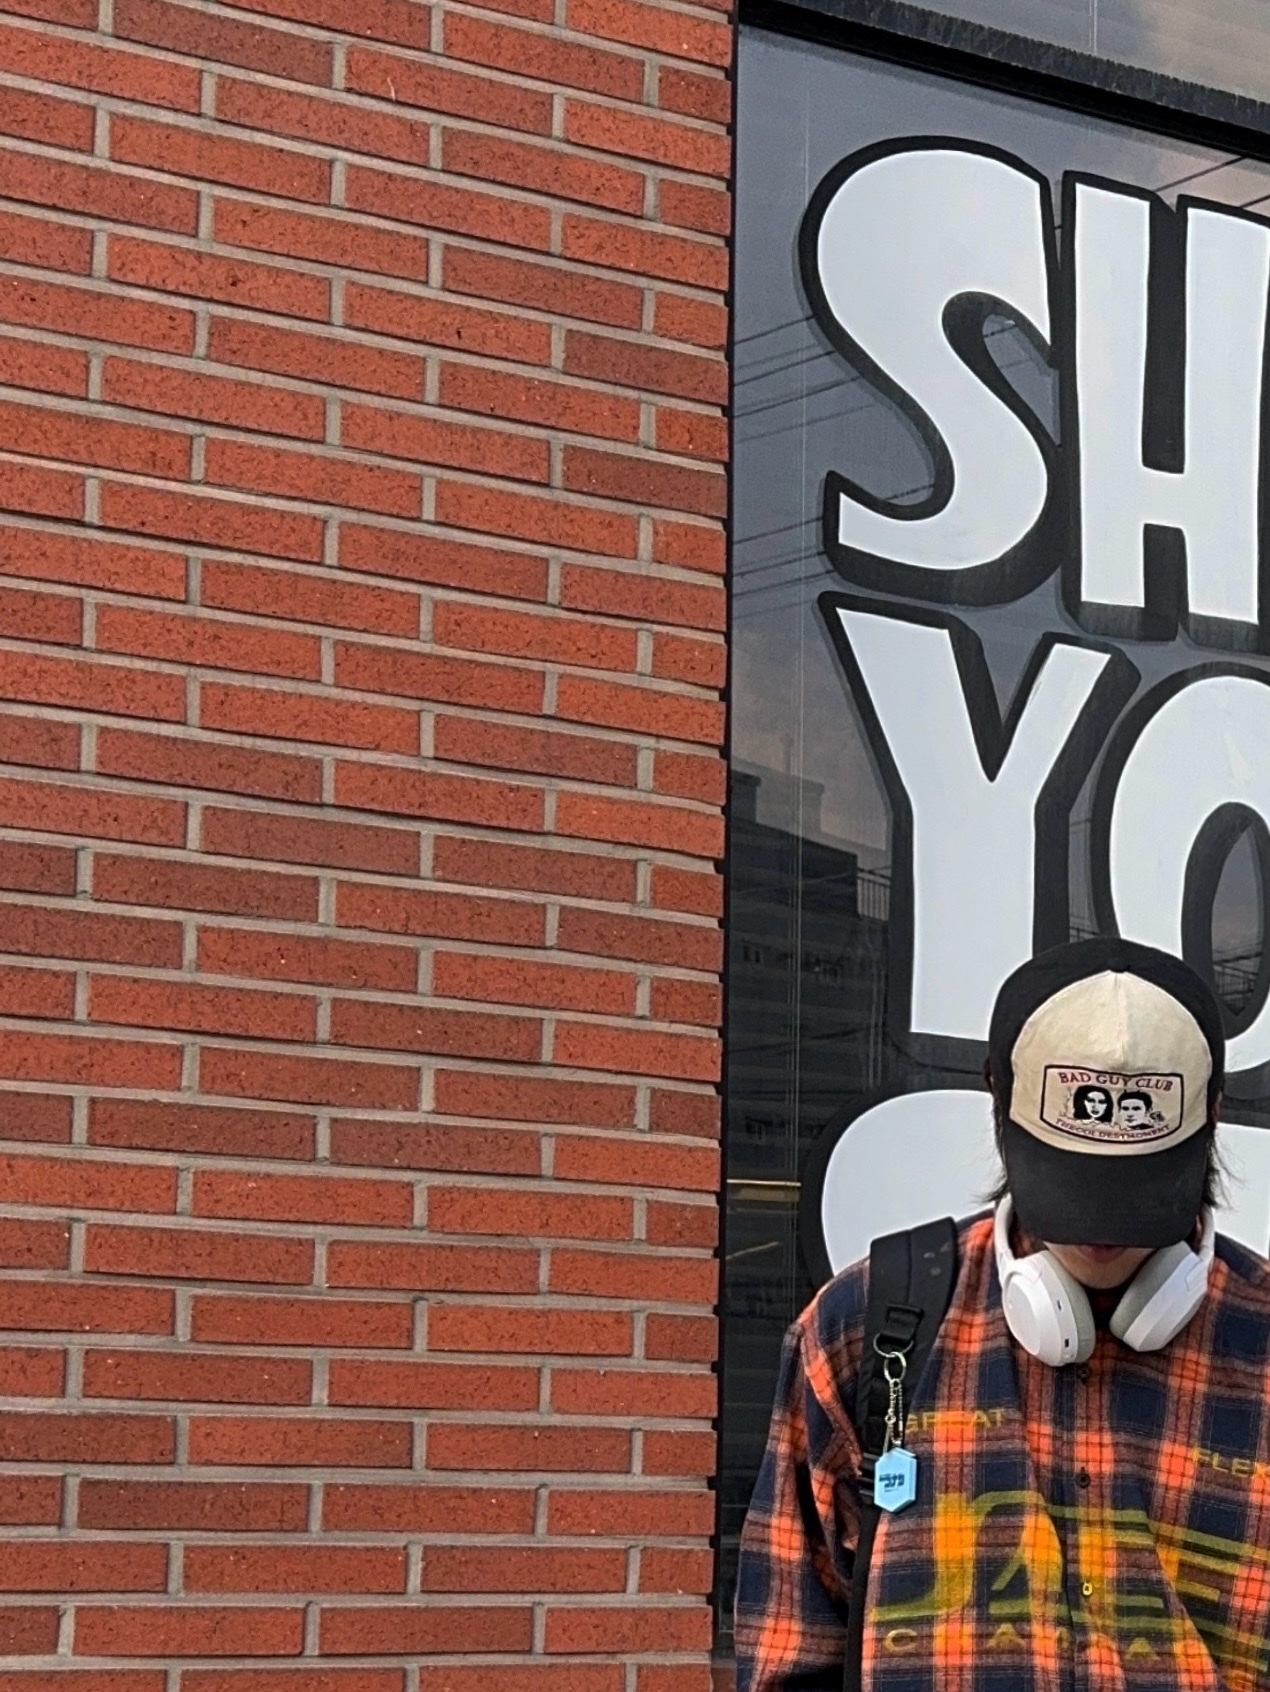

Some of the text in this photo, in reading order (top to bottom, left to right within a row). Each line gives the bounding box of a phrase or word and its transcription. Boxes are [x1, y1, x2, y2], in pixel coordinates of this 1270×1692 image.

[1058, 1072, 1174, 1092] BAD GUY CLUB
